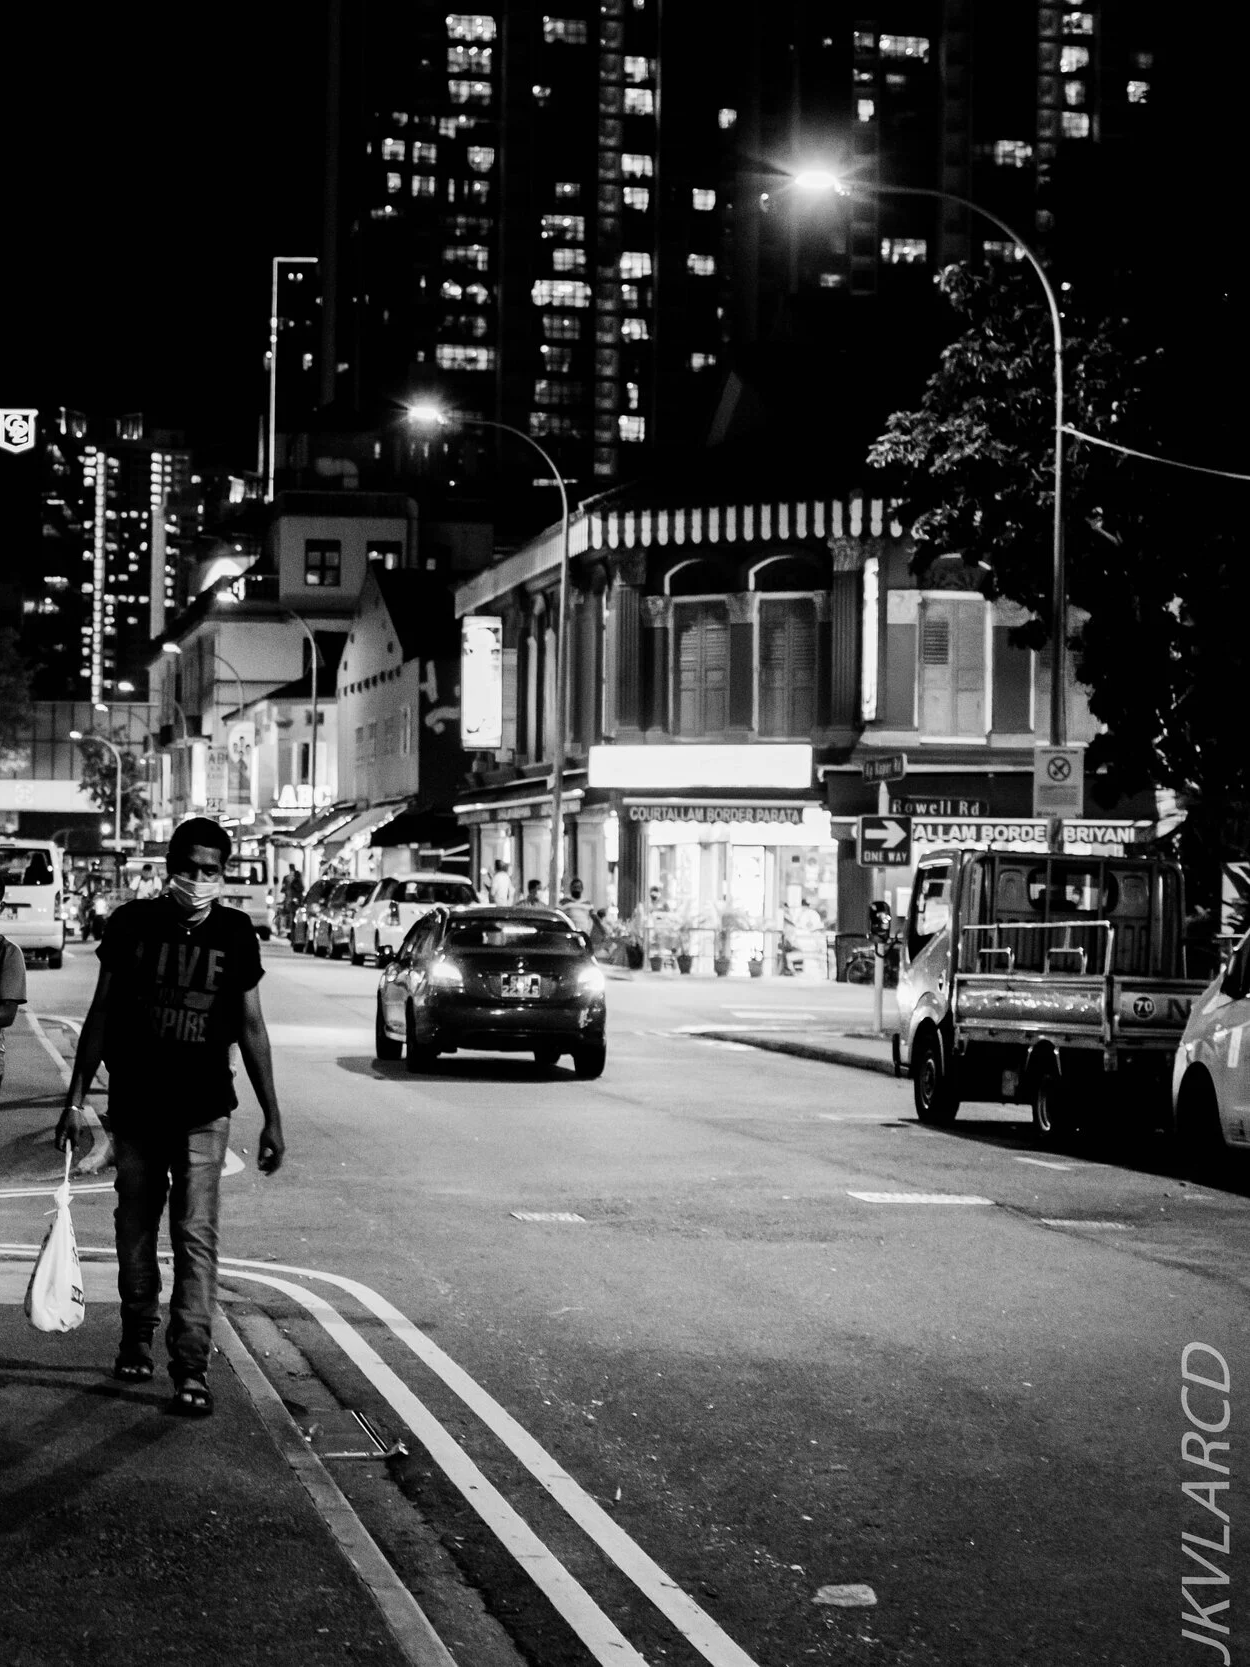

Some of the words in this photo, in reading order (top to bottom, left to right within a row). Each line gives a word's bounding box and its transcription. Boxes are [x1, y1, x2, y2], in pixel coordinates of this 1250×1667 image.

[277, 784, 332, 808] ABC
[629, 806, 704, 822] COURTALLAM
[706, 807, 755, 823] BORDER
[756, 808, 800, 824] PARATA
[892, 798, 952, 815] Rowell
[958, 800, 980, 816] Rd
[912, 824, 978, 841] ALLAM
[980, 825, 1046, 842] BORDE
[1062, 826, 1136, 843] BRIYANI
[863, 850, 885, 862] ONE
[888, 851, 908, 862] WAY
[154, 941, 226, 992] IVE
[1135, 1000, 1153, 1012] 70
